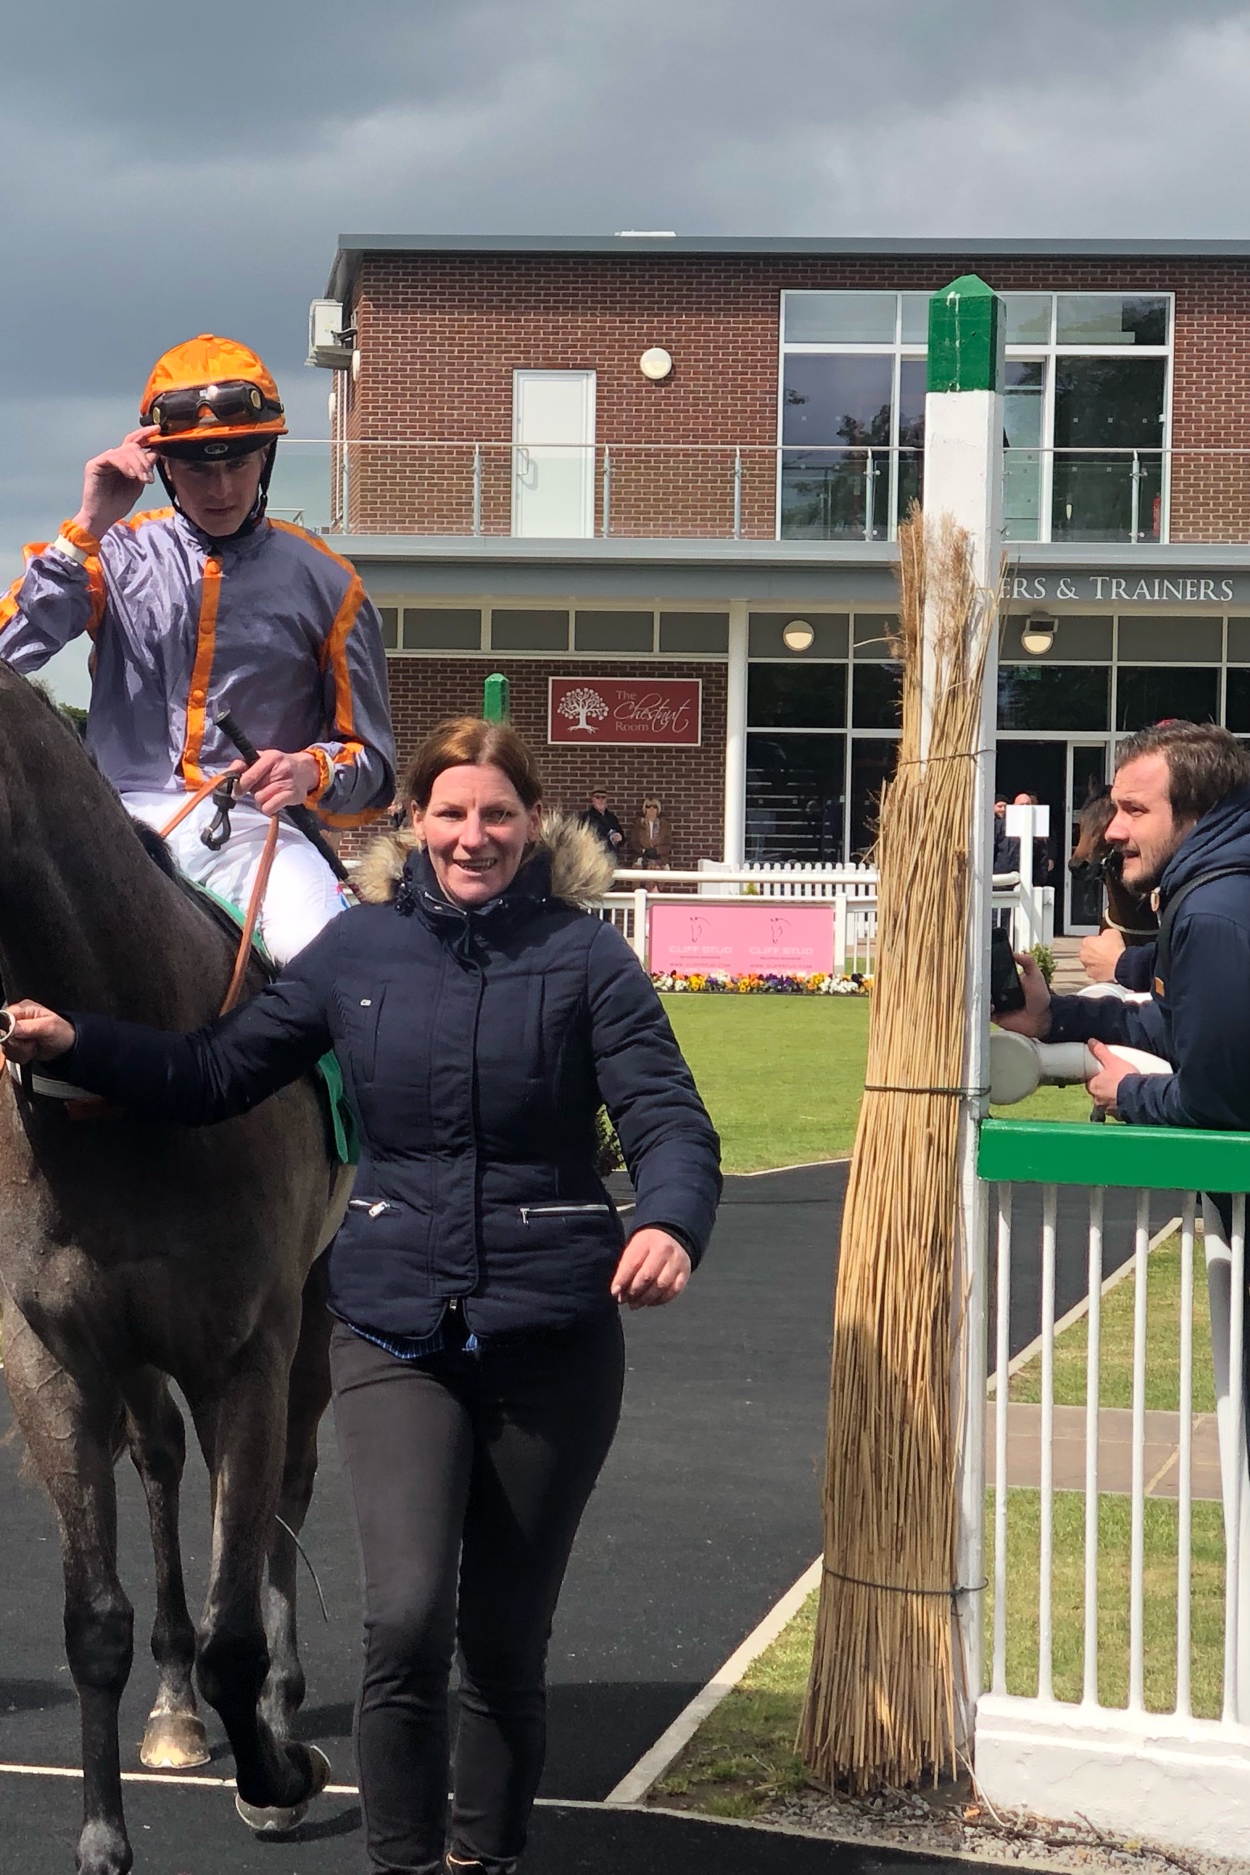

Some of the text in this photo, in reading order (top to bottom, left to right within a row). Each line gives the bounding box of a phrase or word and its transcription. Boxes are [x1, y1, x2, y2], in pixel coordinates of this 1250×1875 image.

[1056, 578, 1080, 599] &
[1090, 576, 1234, 601] TRAINERS
[615, 690, 637, 700] The
[613, 692, 692, 733] Chestnut
[615, 721, 650, 731] Room
[701, 946, 733, 954] STUD
[782, 947, 814, 955] STUD
